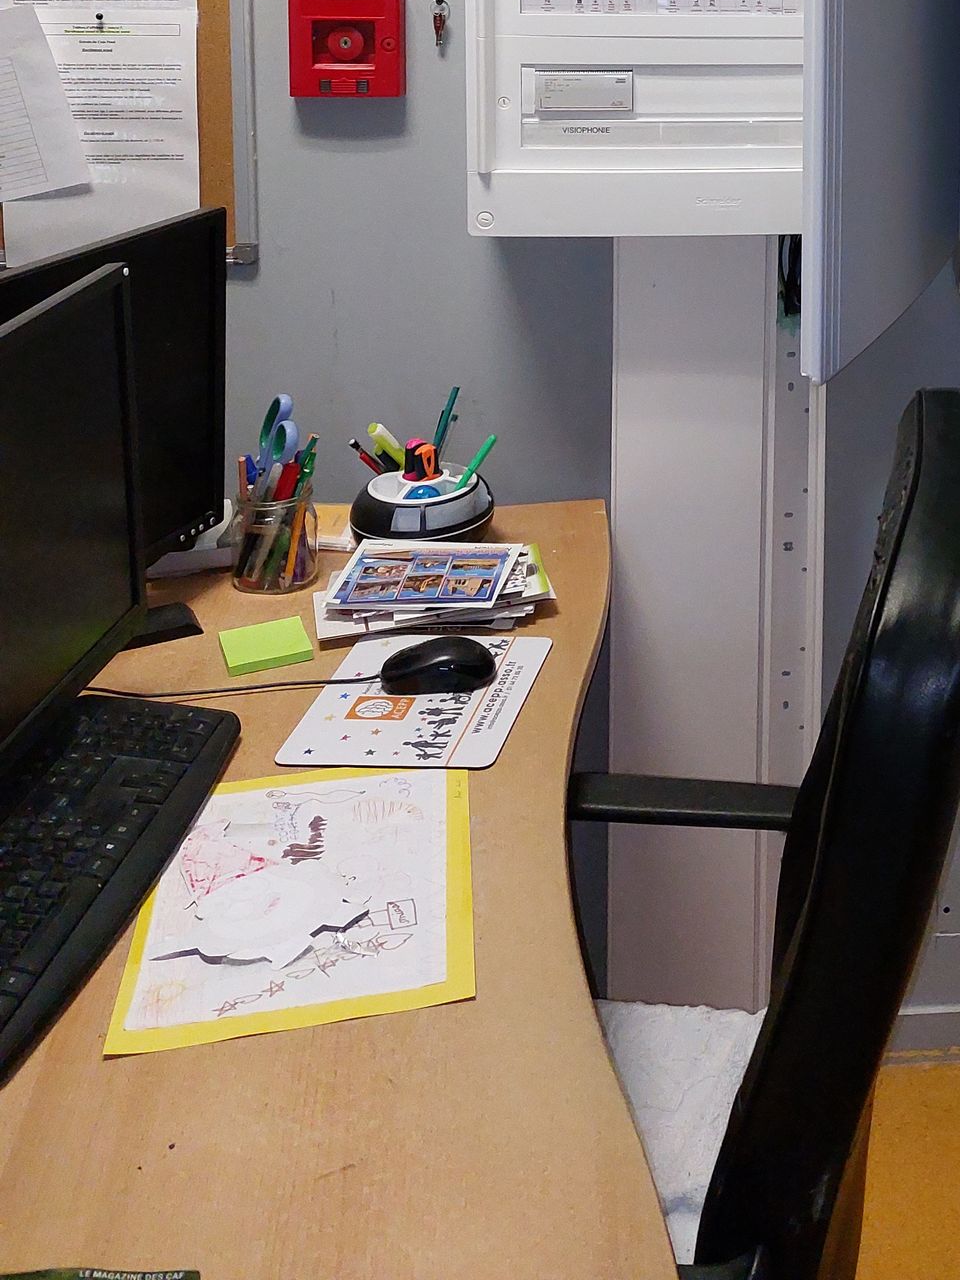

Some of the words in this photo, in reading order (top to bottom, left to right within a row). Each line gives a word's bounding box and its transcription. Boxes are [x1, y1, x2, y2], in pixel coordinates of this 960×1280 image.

[561, 126, 611, 134] VISIOPHONIE
[471, 661, 517, 734] www.acepp.asso.fr
[78, 1270, 89, 1278] LE
[92, 1271, 142, 1280] MAGAZINE
[166, 1272, 185, 1280] CAF
